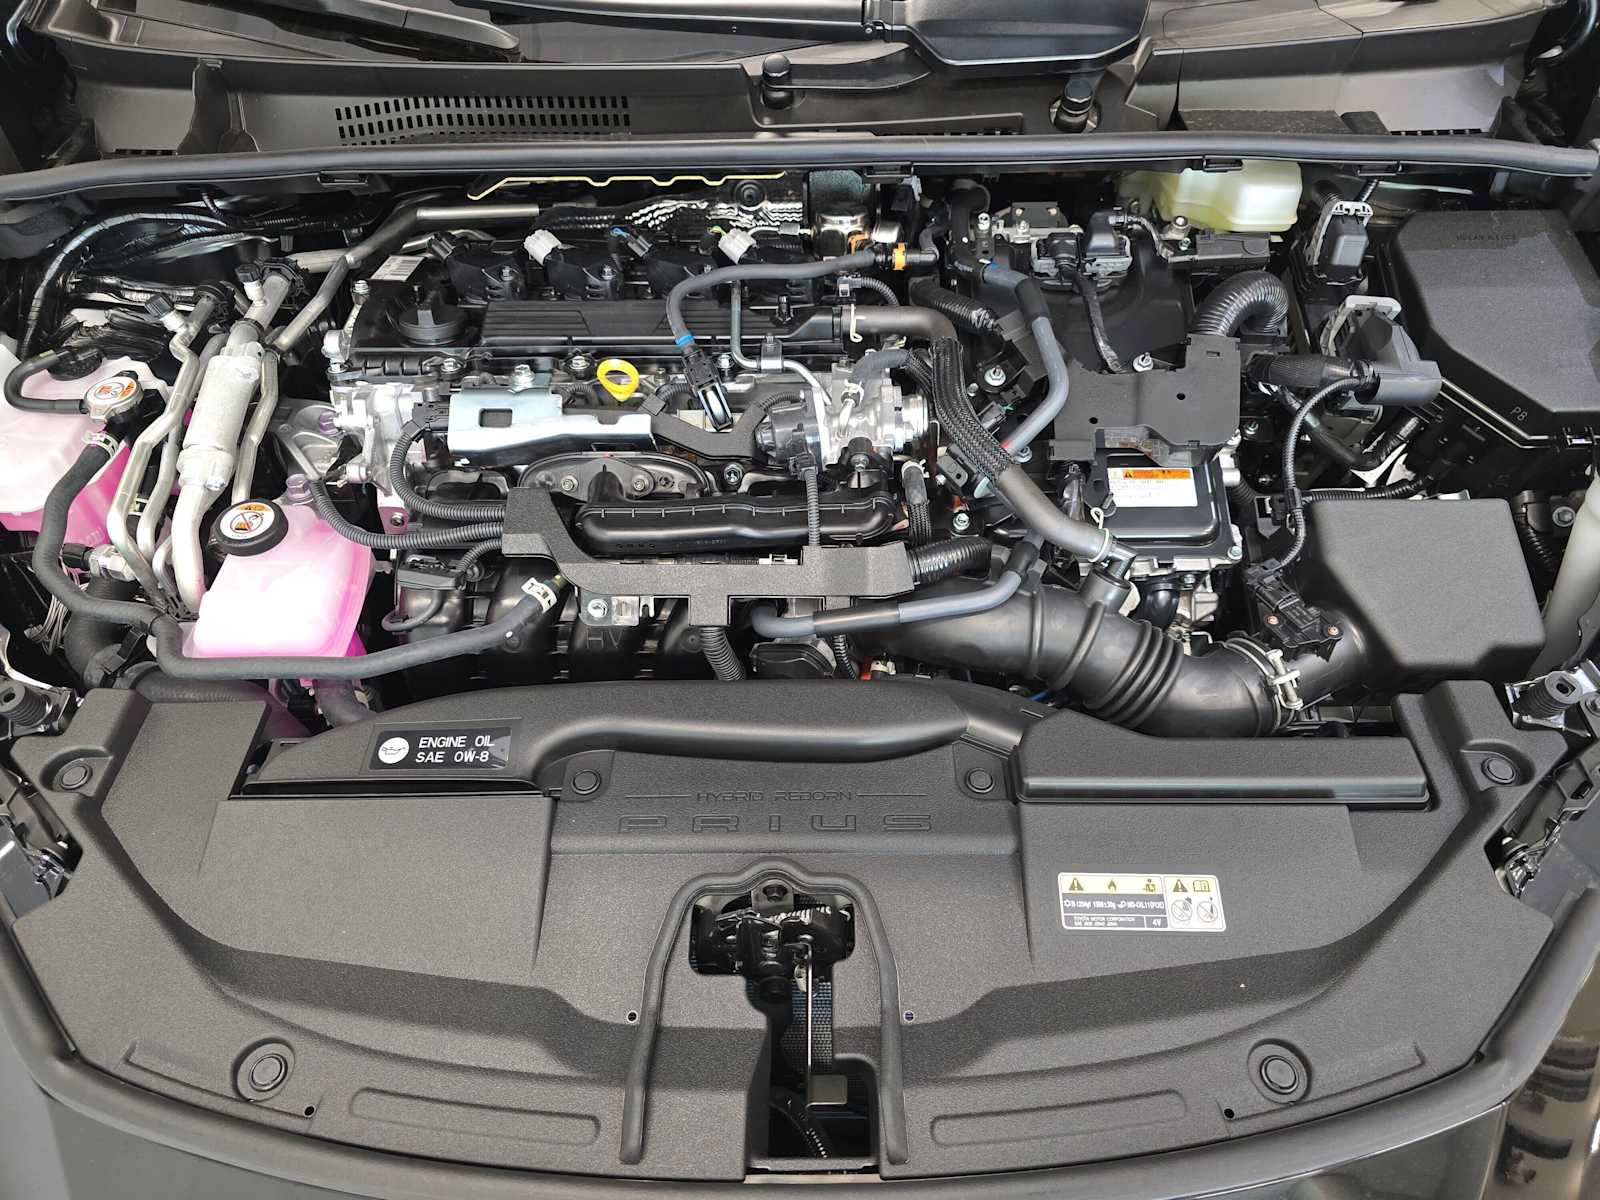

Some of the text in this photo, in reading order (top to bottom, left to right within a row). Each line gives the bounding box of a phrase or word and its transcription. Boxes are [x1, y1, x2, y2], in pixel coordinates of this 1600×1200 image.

[1511, 406, 1528, 421] P8
[419, 735, 495, 748] ENGINE OIL
[415, 751, 445, 763] SAE
[697, 791, 851, 801] HYBRID REBORN
[618, 814, 932, 833] PRIUS
